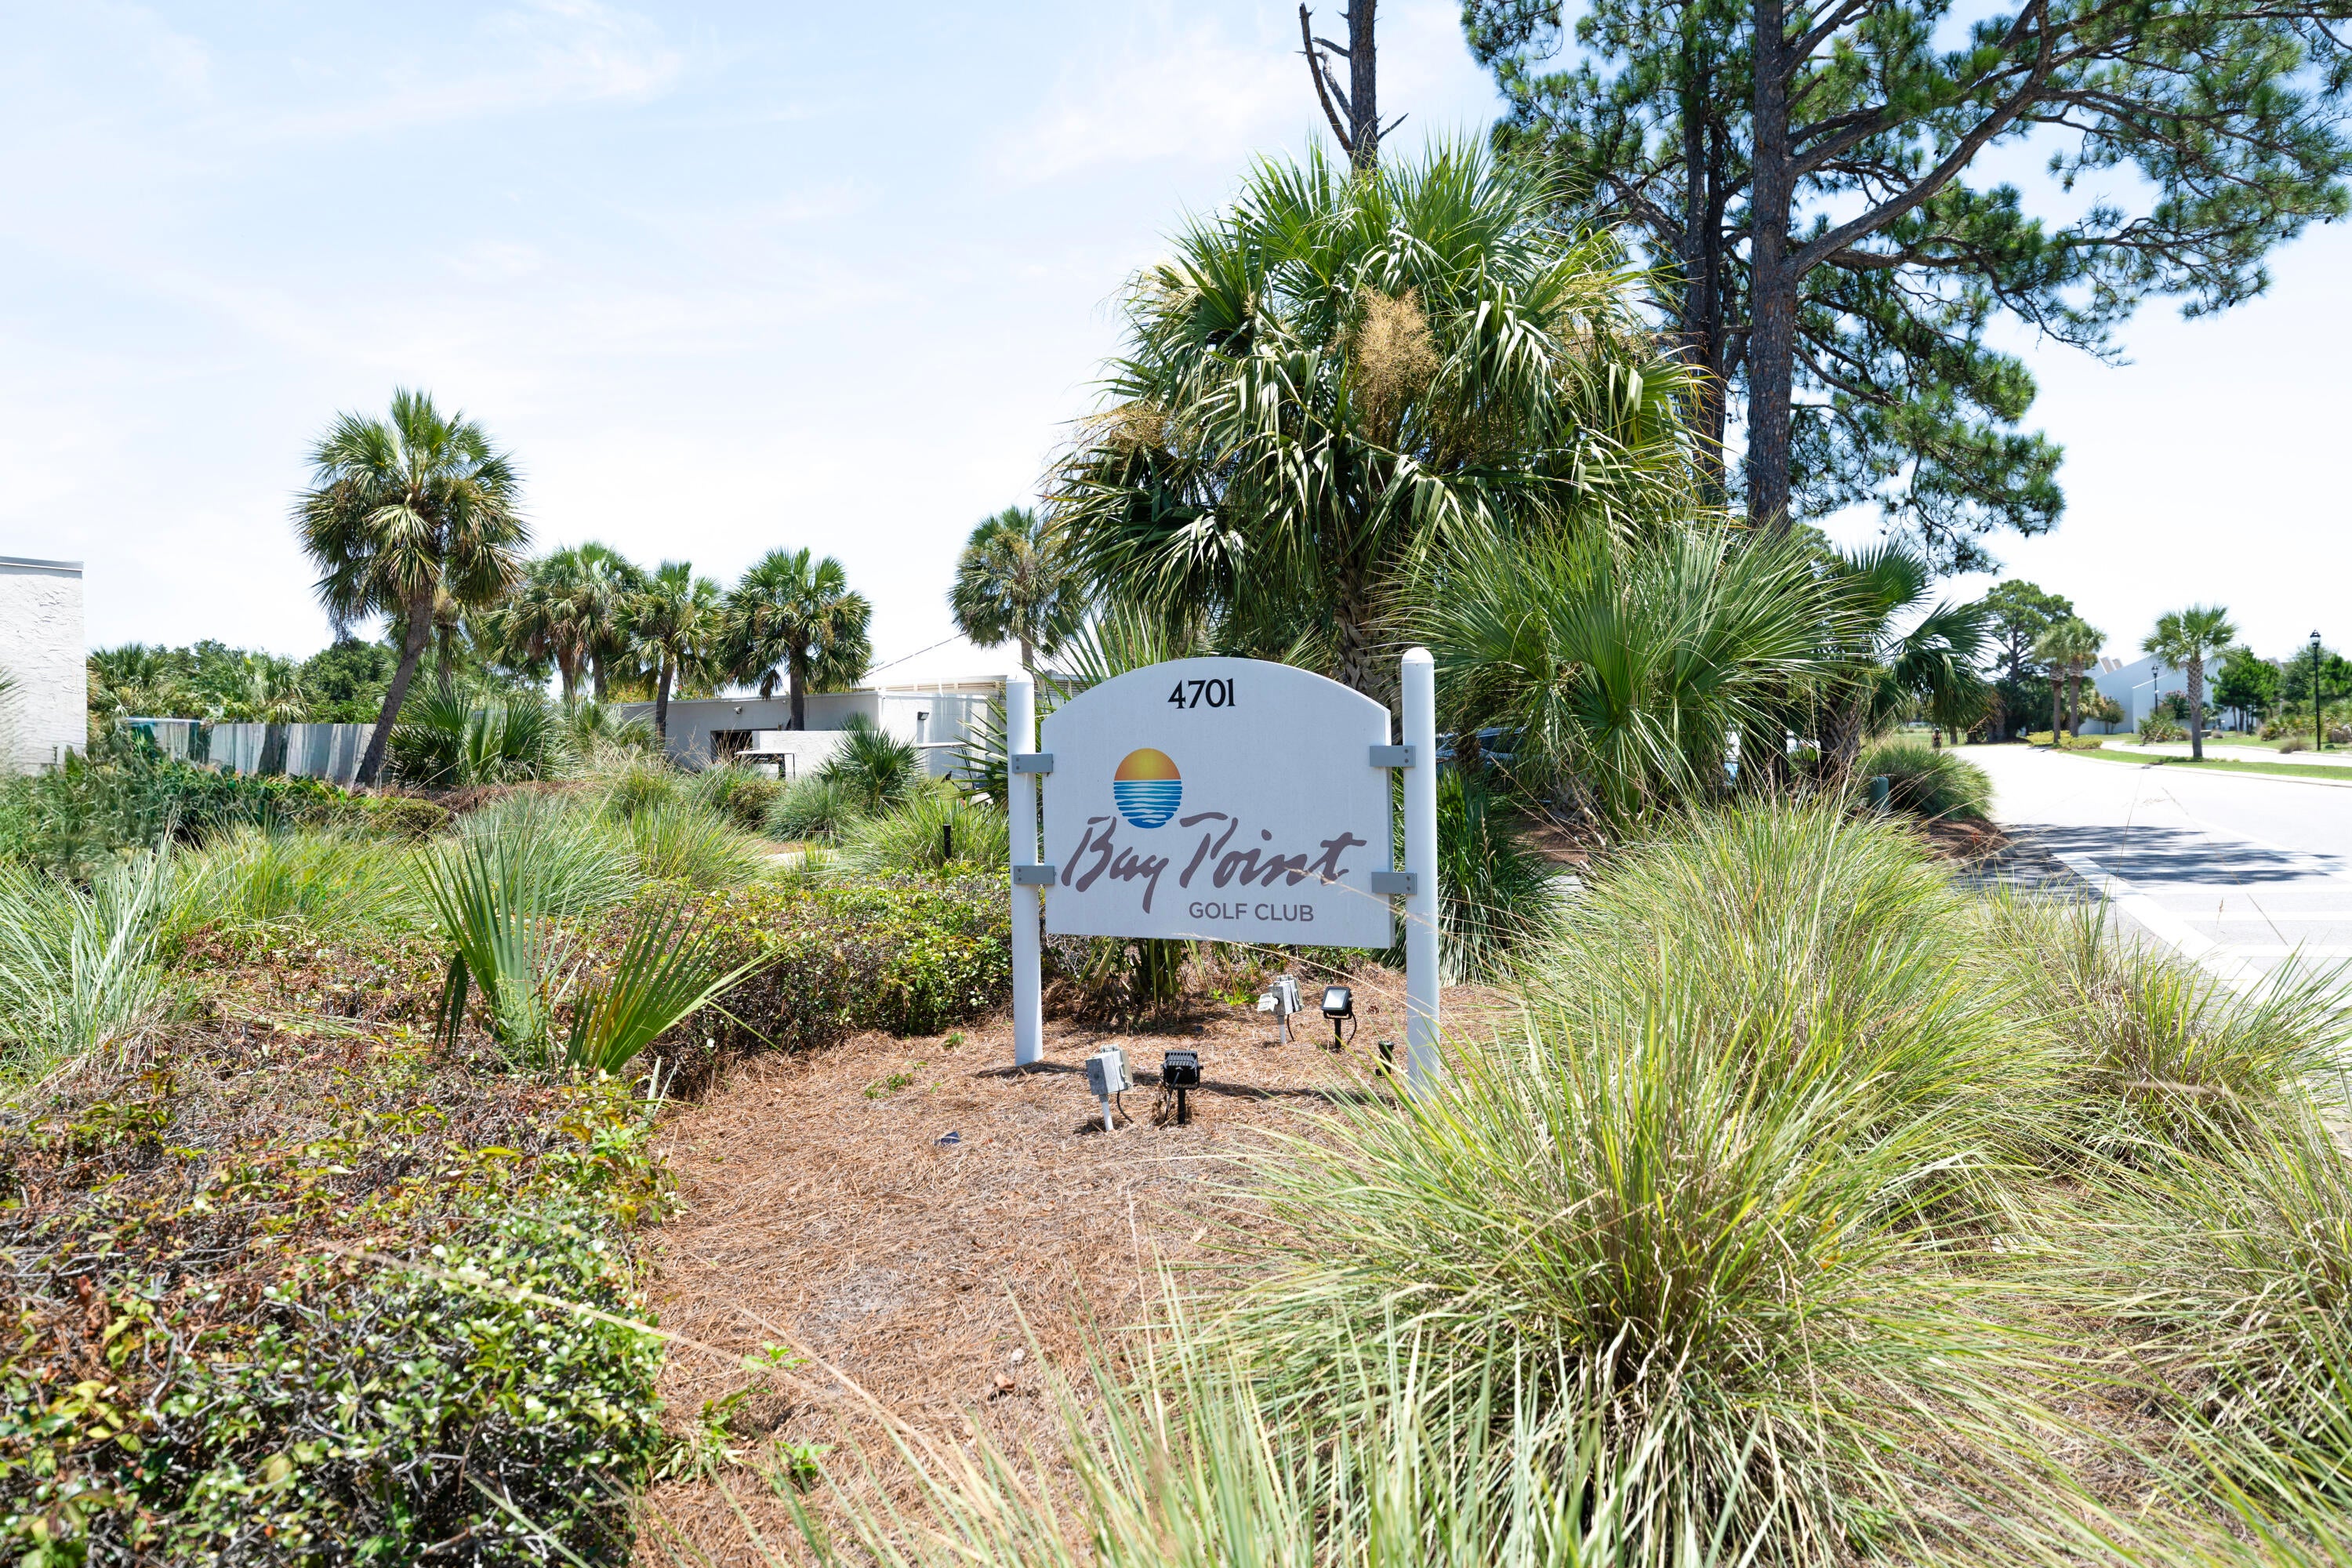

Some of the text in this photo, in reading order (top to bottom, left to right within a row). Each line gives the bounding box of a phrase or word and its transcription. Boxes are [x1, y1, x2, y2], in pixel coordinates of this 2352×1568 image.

[1167, 677, 1236, 709] 4701
[1061, 811, 1367, 914] Bay Point
[1189, 902, 1314, 921] GOLF CLUB
